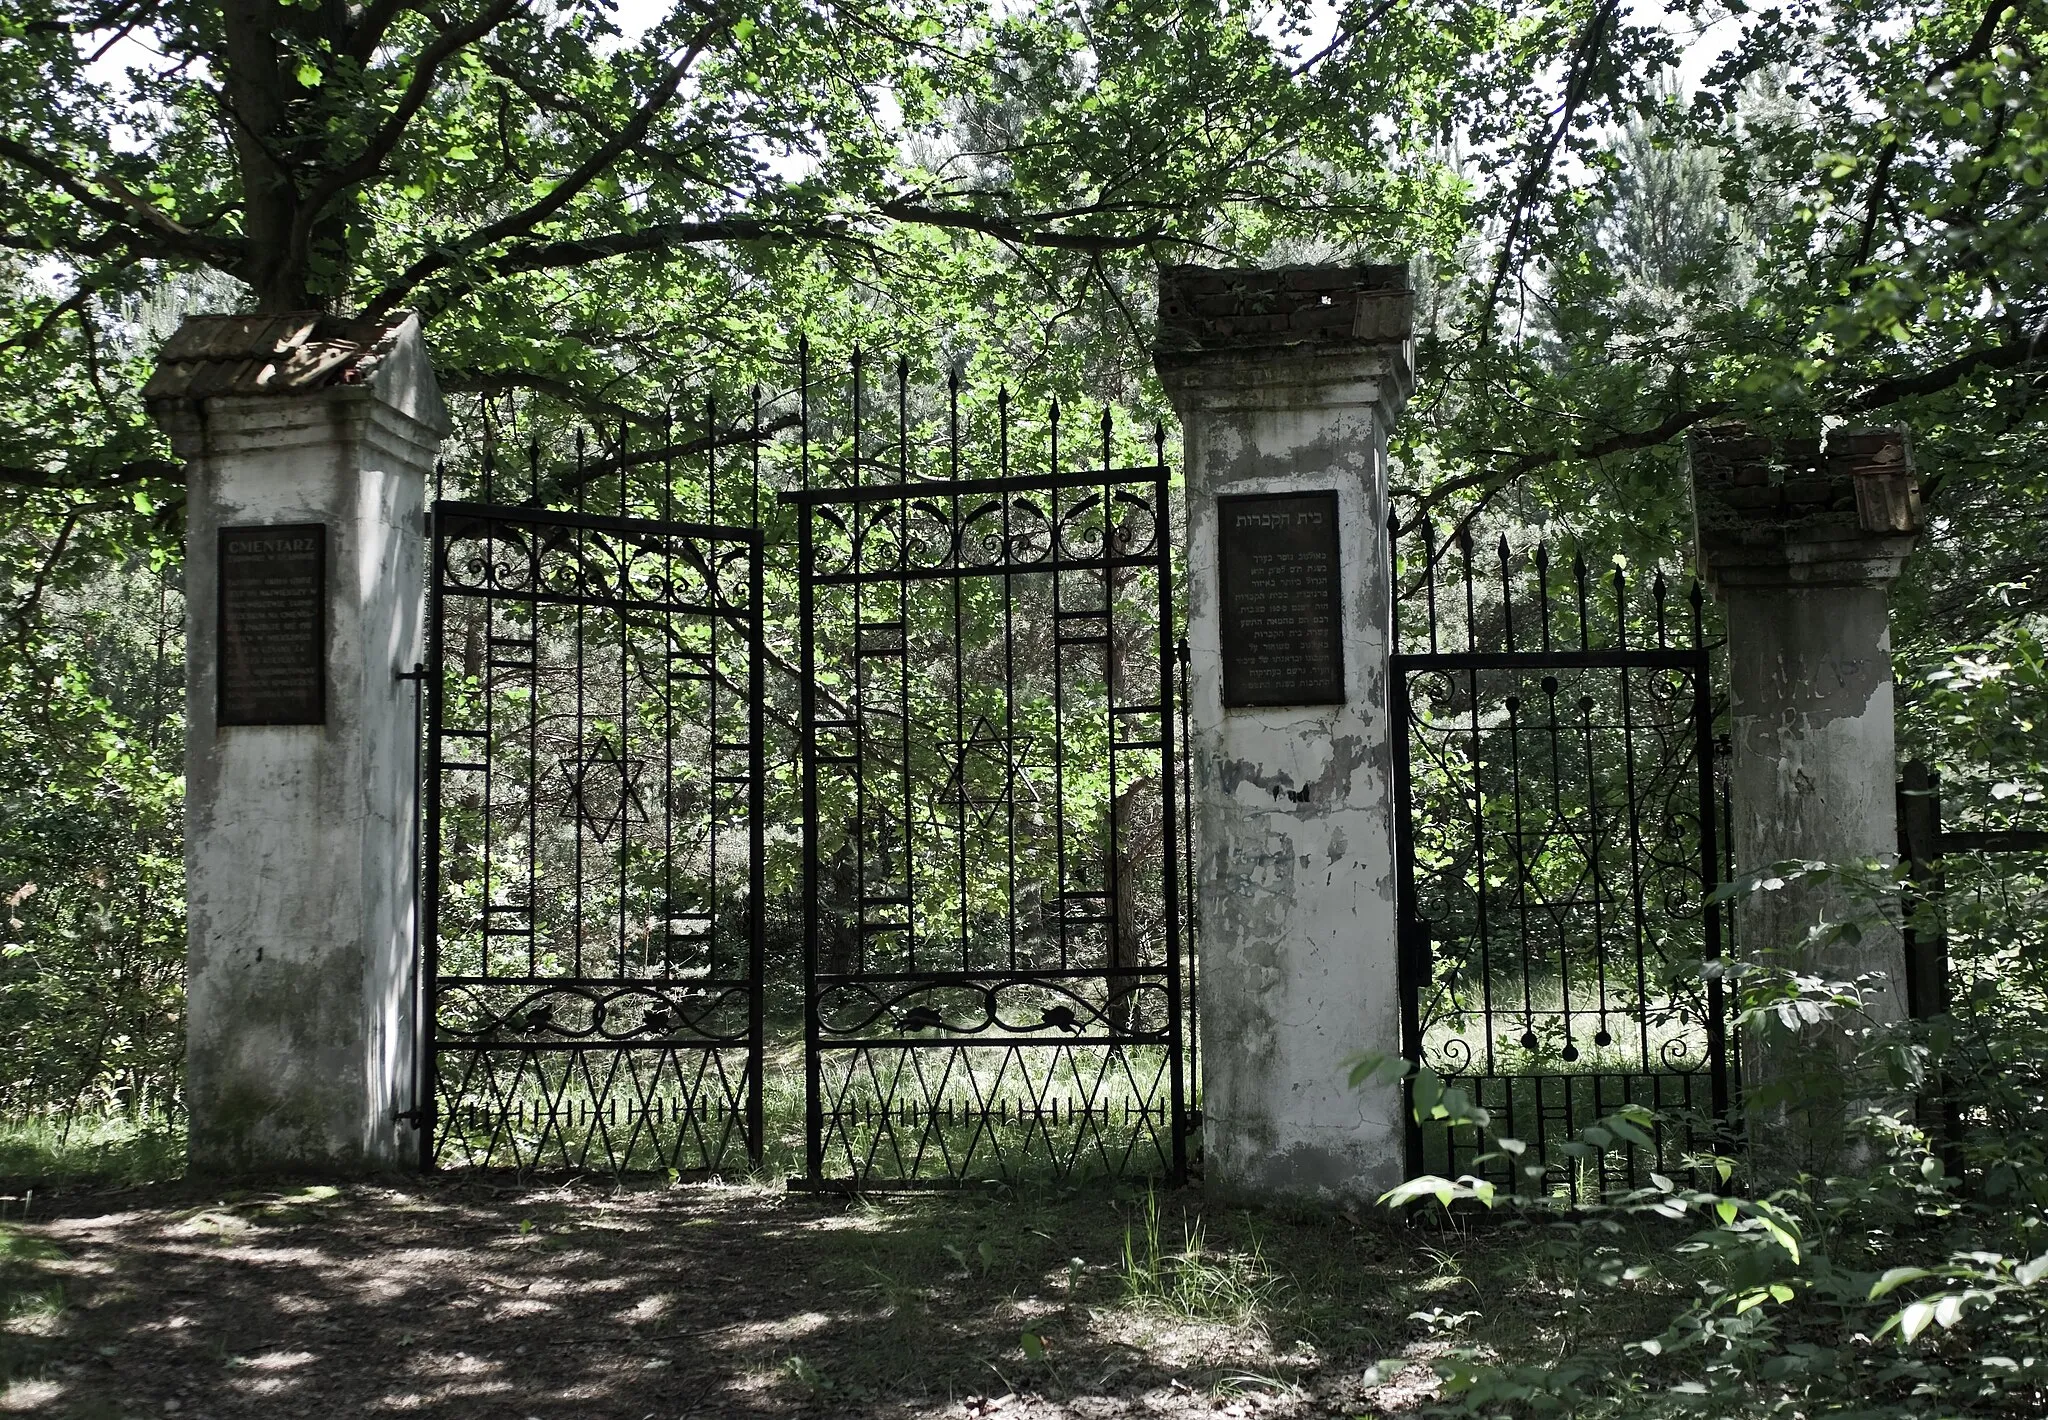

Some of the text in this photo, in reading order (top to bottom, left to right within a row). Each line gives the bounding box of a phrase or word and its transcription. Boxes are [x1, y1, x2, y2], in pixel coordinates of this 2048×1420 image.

[1236, 512, 1322, 530] בית הקברות
[228, 538, 315, 553] CMENTARZ
